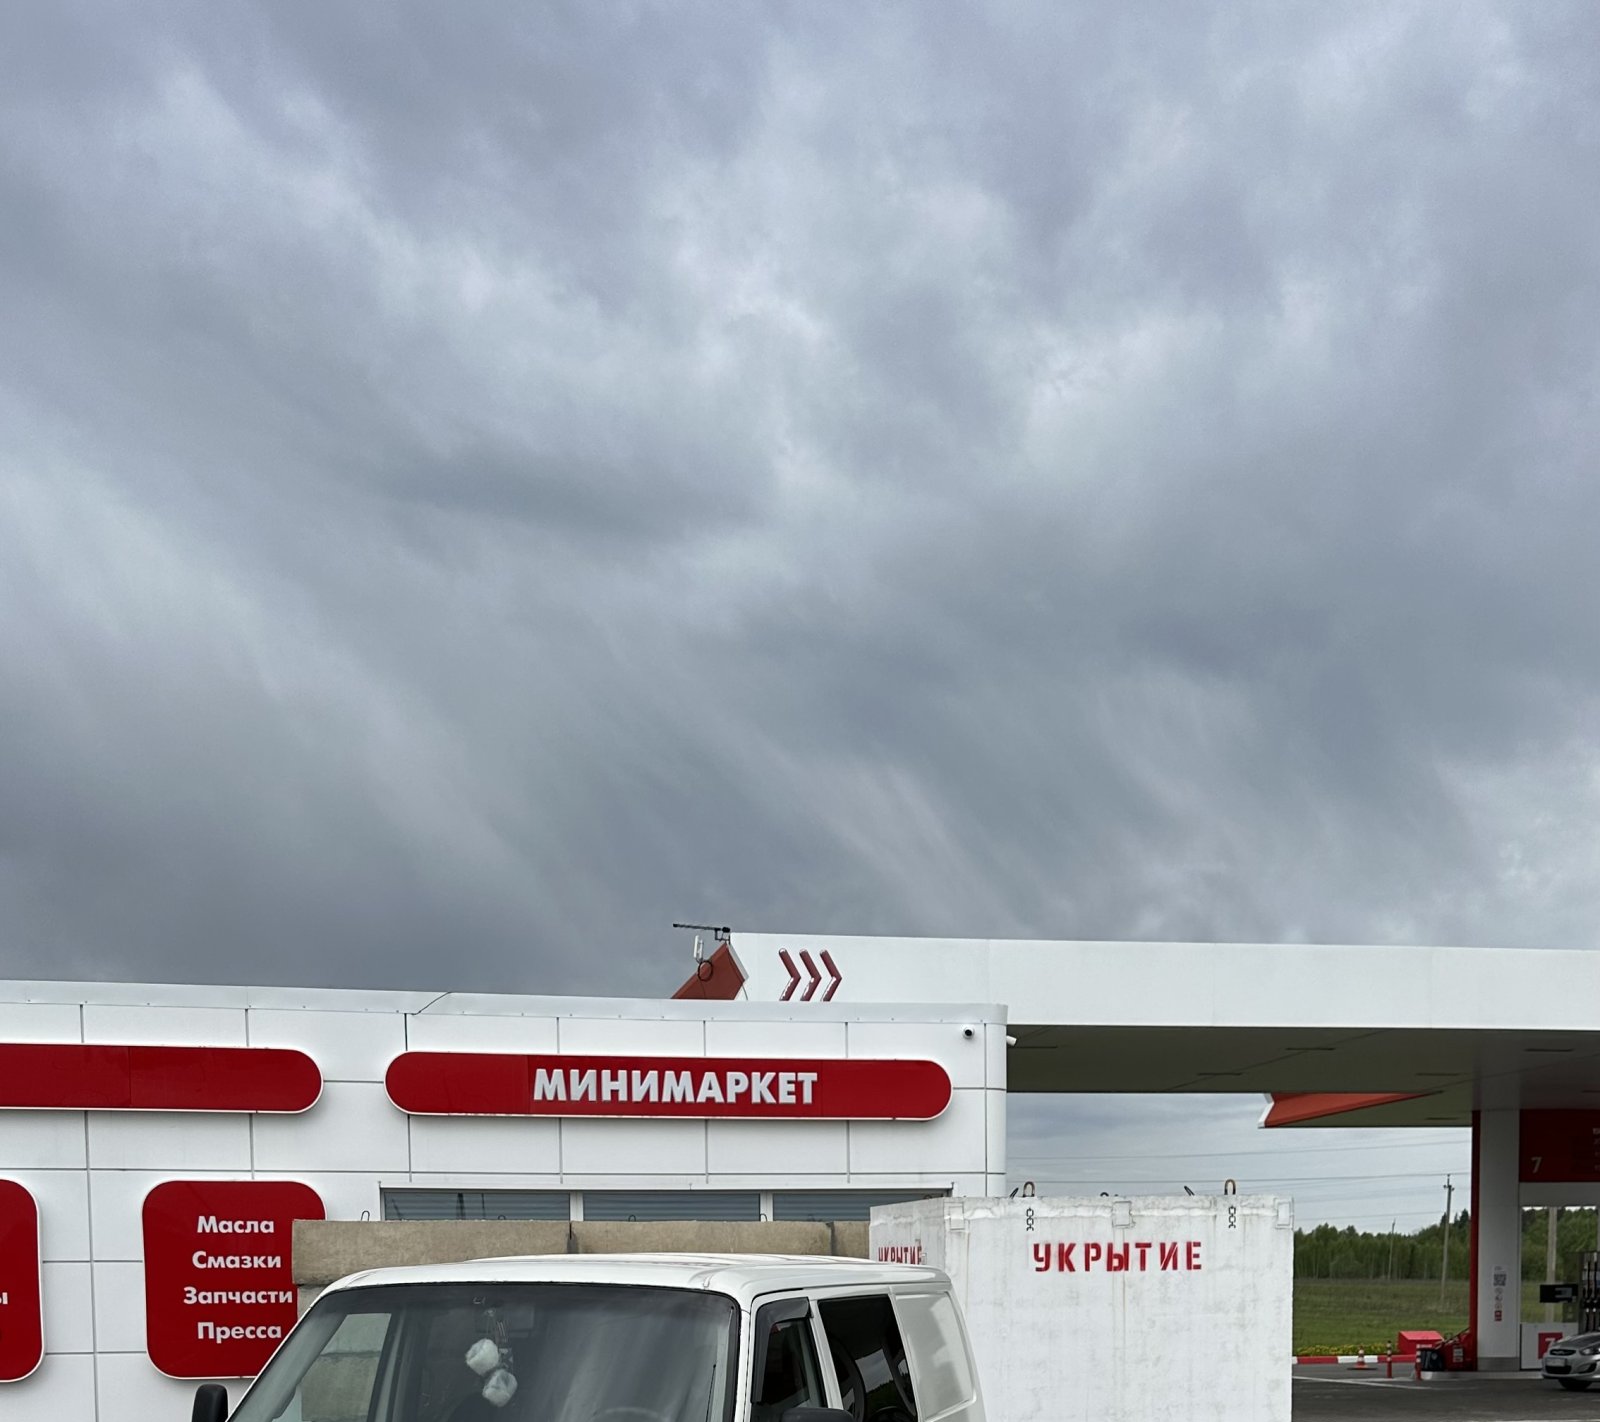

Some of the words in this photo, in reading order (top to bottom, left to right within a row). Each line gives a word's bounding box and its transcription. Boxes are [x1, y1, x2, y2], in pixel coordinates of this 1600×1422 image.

[534, 1068, 818, 1104] МИНИМАРКЕТ
[1531, 1156, 1542, 1174] 7
[197, 1215, 275, 1233] Масла
[192, 1250, 282, 1269] Смазки
[1033, 1241, 1202, 1272] УКРЫТИЕ
[183, 1286, 293, 1305] Запчасти
[197, 1321, 282, 1344] Пресса
